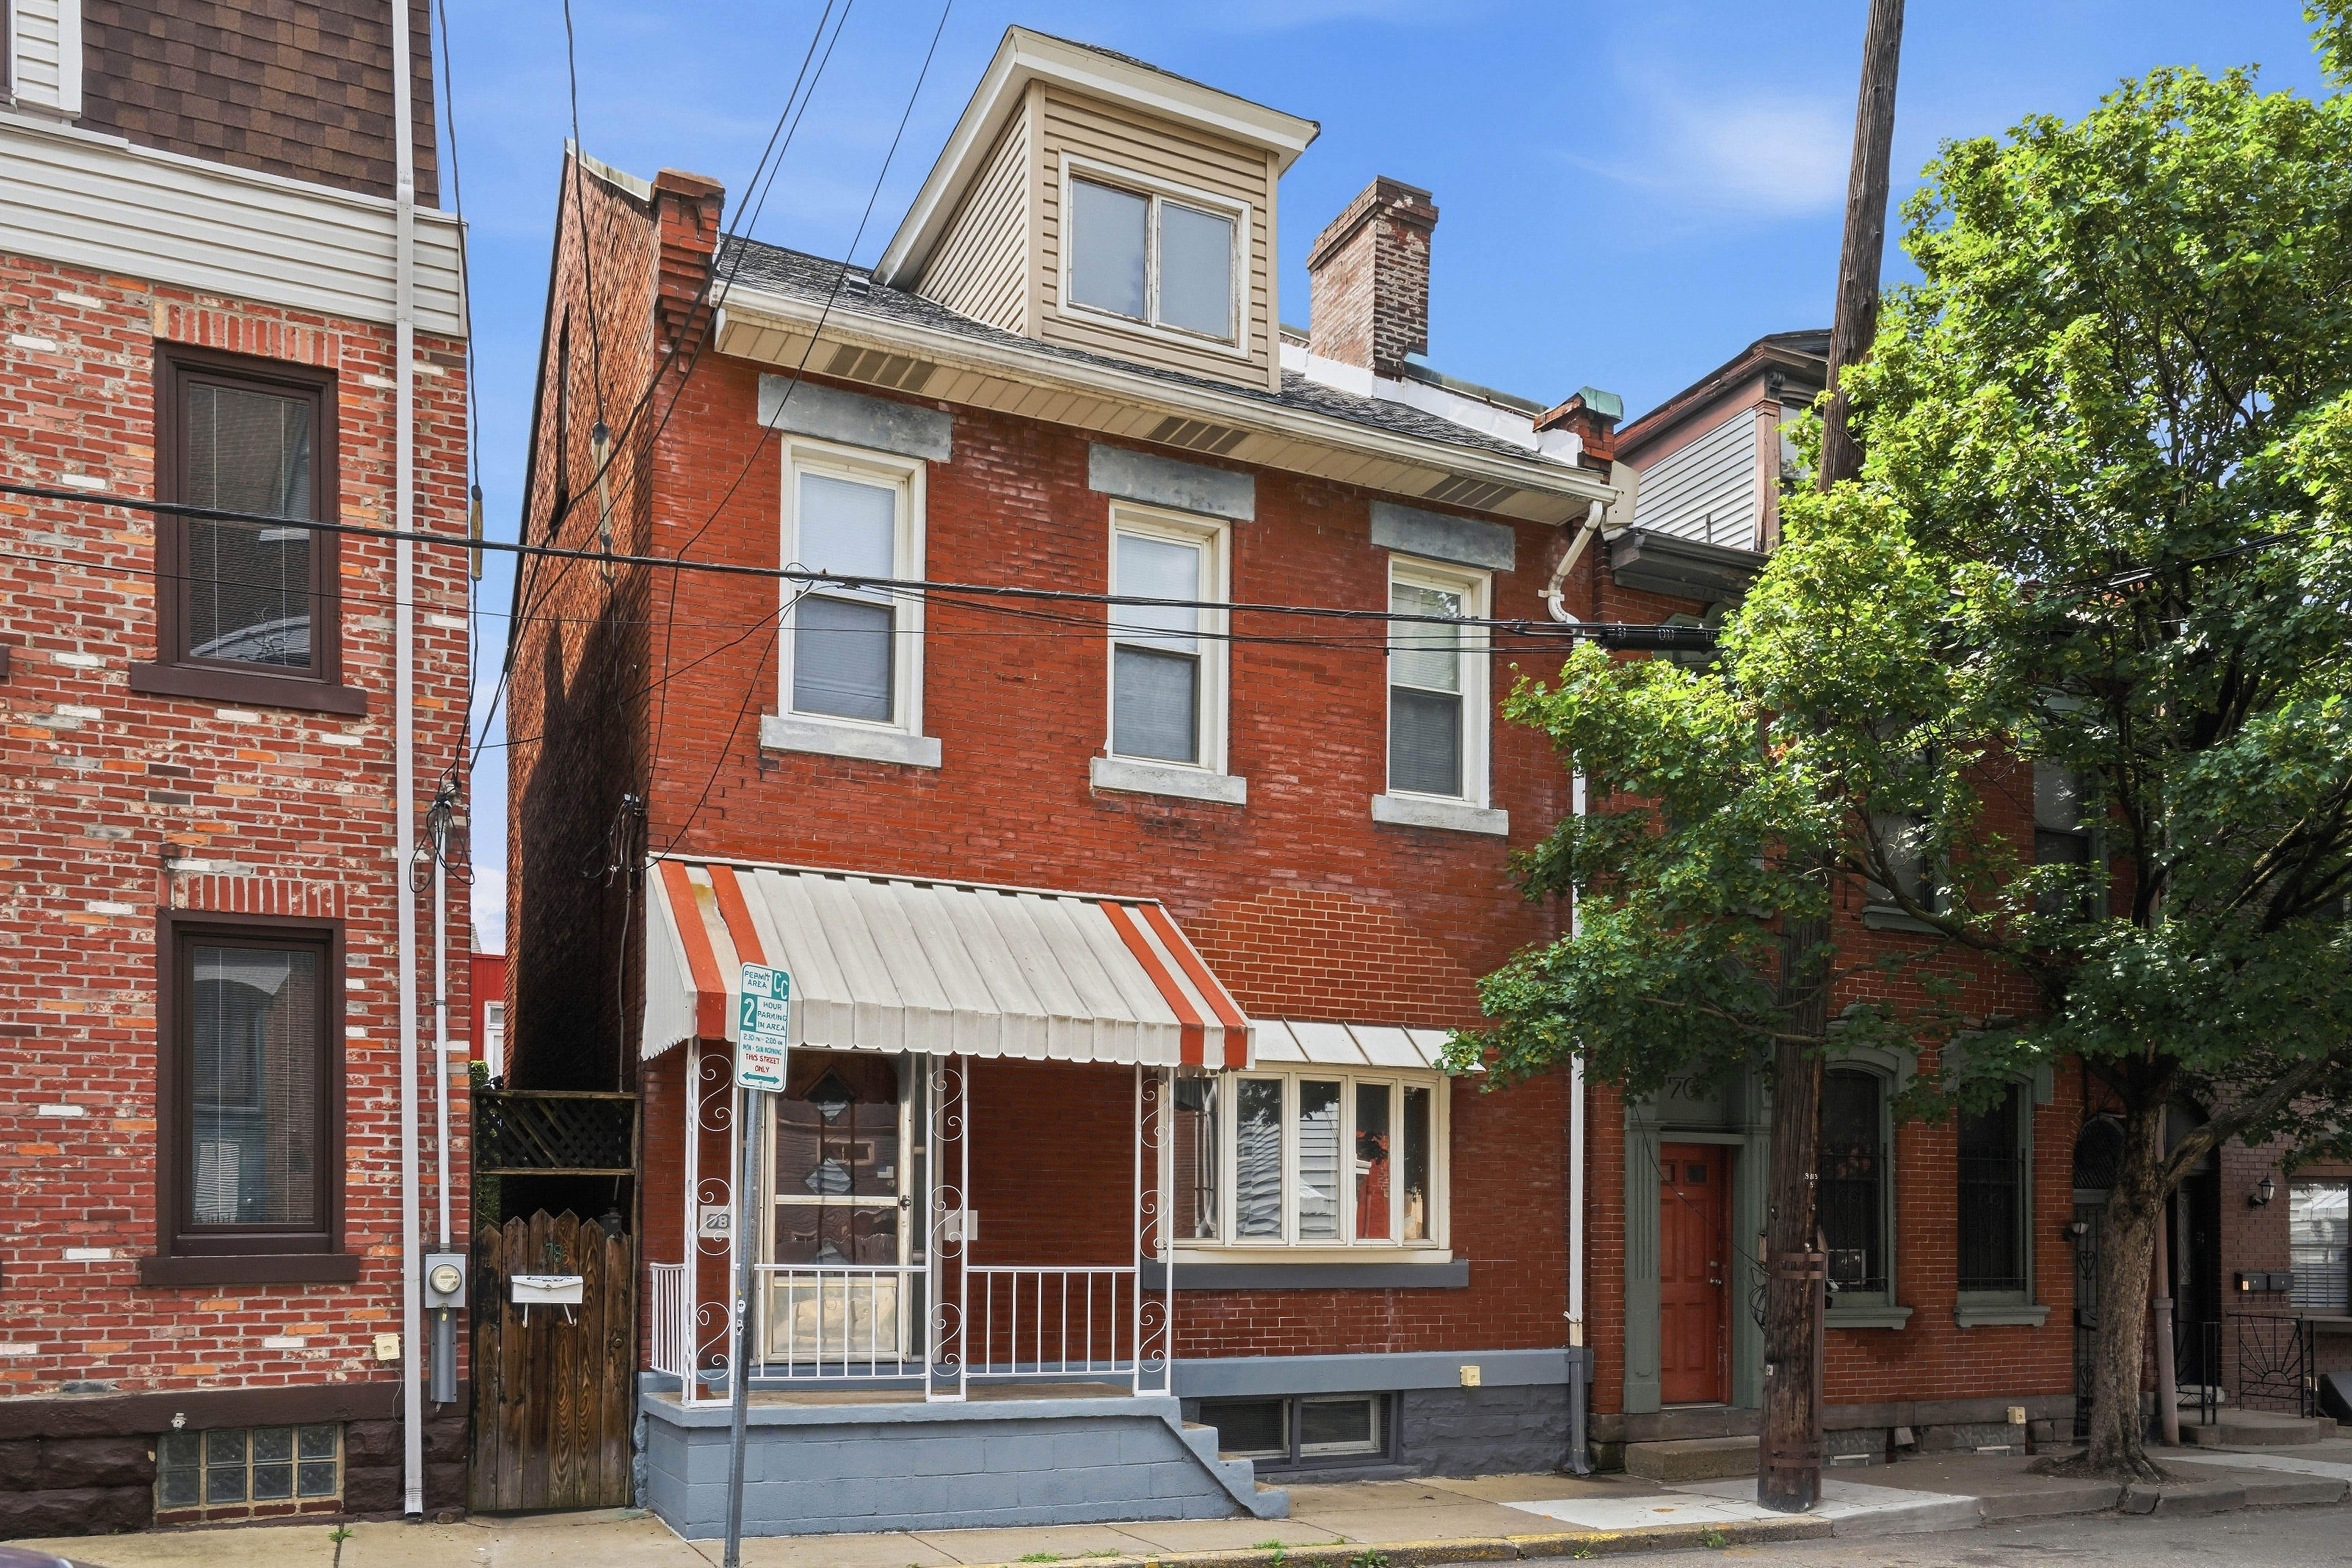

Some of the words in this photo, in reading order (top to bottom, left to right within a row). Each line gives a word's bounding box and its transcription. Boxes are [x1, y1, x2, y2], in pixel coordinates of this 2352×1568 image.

[744, 971, 771, 981] PERMIT
[747, 979, 767, 989] AREA
[763, 1001, 782, 1010] HOUR
[743, 998, 755, 1027] 2
[757, 1011, 788, 1022] PARKING
[766, 1023, 785, 1031] AREA
[759, 1055, 780, 1065] STREET
